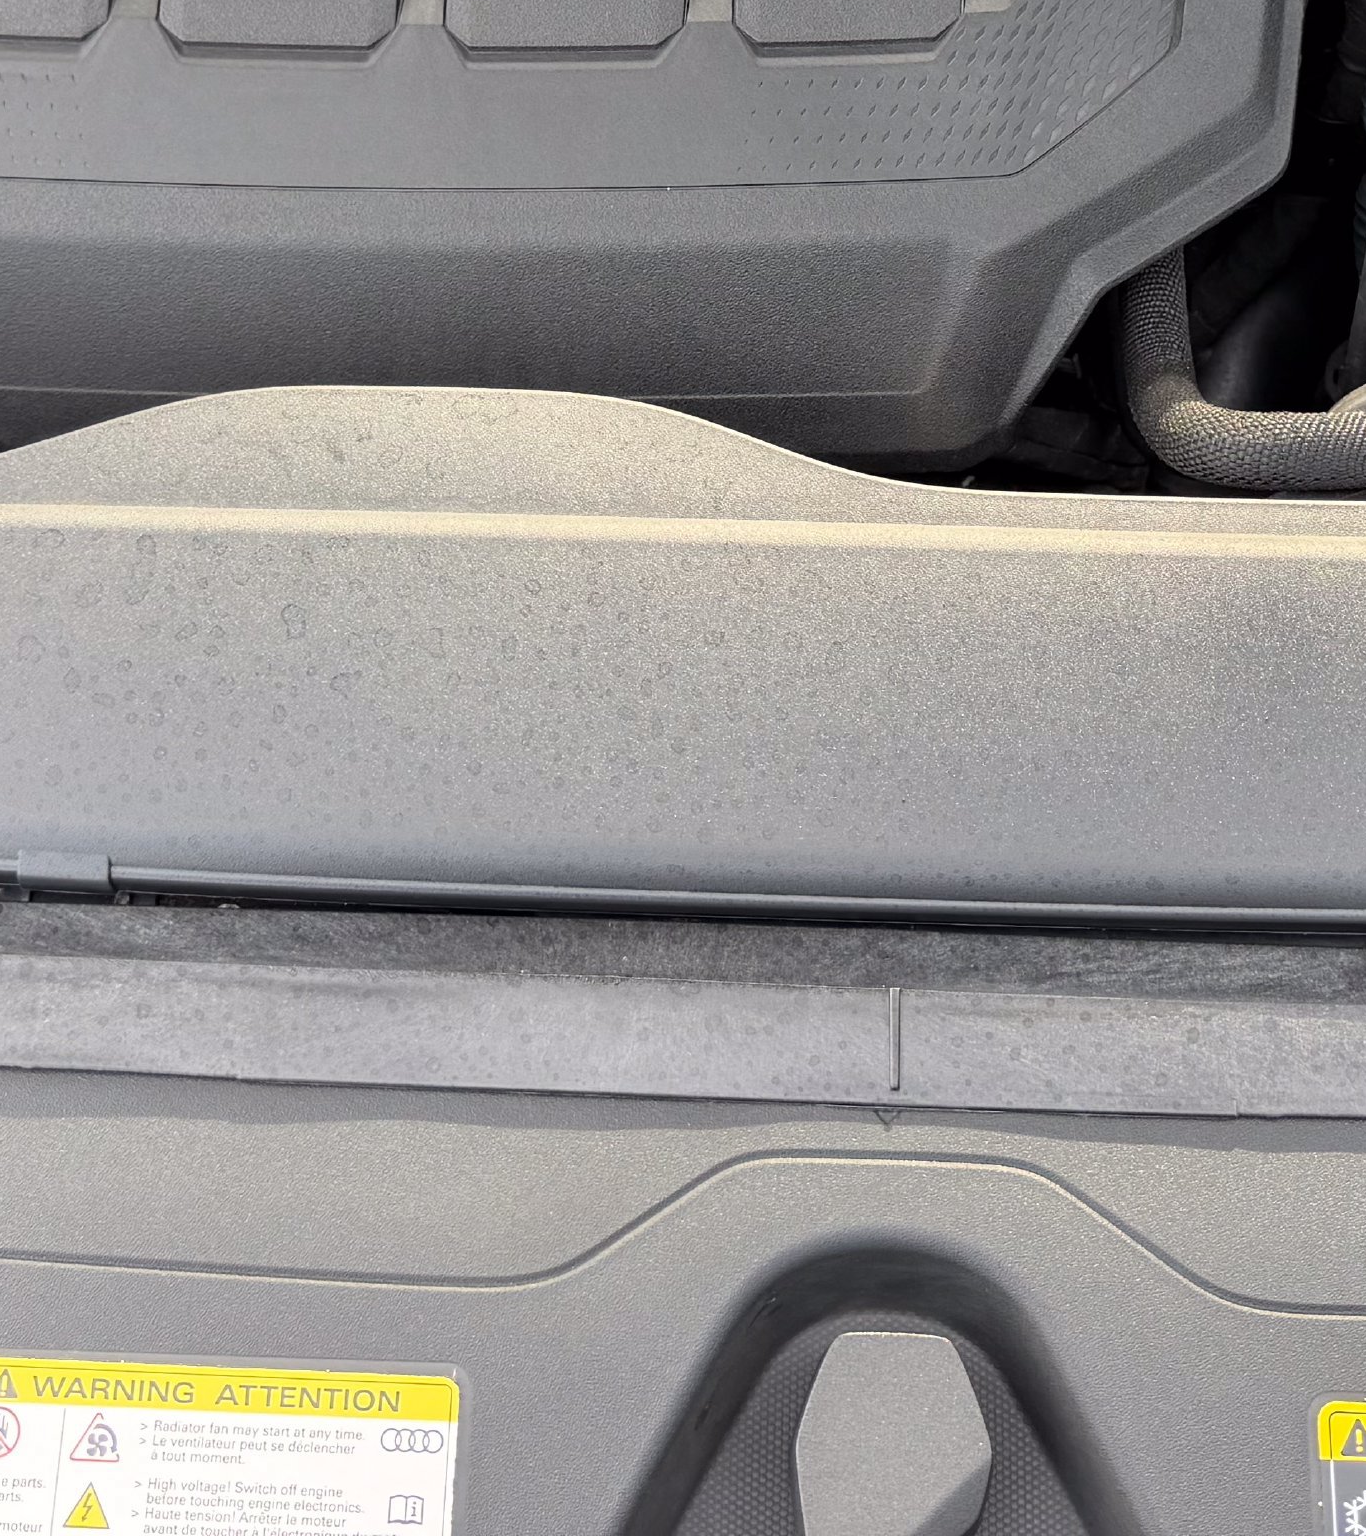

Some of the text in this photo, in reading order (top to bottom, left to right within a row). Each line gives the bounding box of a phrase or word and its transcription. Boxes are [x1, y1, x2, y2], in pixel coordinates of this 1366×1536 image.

[32, 1374, 402, 1414] WARNING ATTENTION
[153, 1420, 206, 1434] Radiator
[209, 1421, 230, 1435] fan
[232, 1425, 258, 1439] may
[262, 1425, 290, 1438] start
[294, 1427, 306, 1438] at
[309, 1429, 331, 1442] any
[151, 1435, 355, 1455] Le ventilateur peut se déclencher
[161, 1451, 186, 1463] tout
[147, 1478, 177, 1494] High
[234, 1481, 278, 1496] Switch
[280, 1483, 298, 1496] off
[300, 1486, 343, 1500] engine
[146, 1493, 187, 1506] before
[189, 1495, 245, 1512] touching
[248, 1498, 291, 1513] engine
[143, 1507, 183, 1521] Haute
[285, 1514, 298, 1526] le
[300, 1516, 347, 1529] moteur
[142, 1523, 178, 1536] avant
[180, 1524, 198, 1536] de
